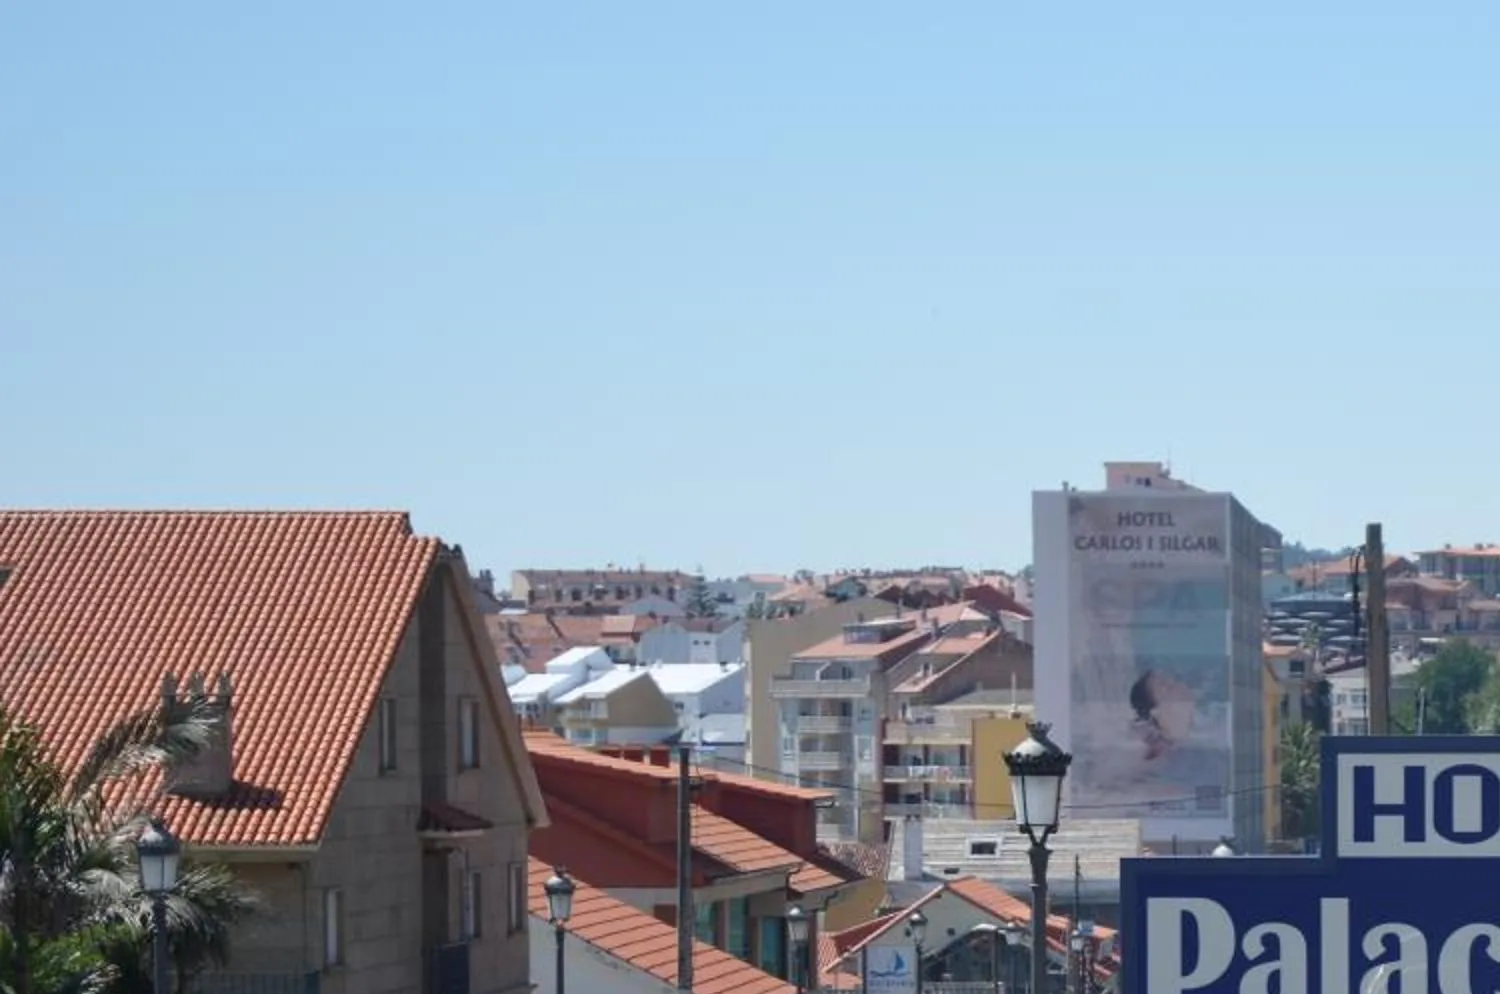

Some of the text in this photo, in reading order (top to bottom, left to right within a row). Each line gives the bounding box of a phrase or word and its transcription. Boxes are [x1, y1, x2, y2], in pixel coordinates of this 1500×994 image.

[1117, 511, 1176, 527] HOTEL
[1073, 534, 1220, 552] CARLOS I SILGAR
